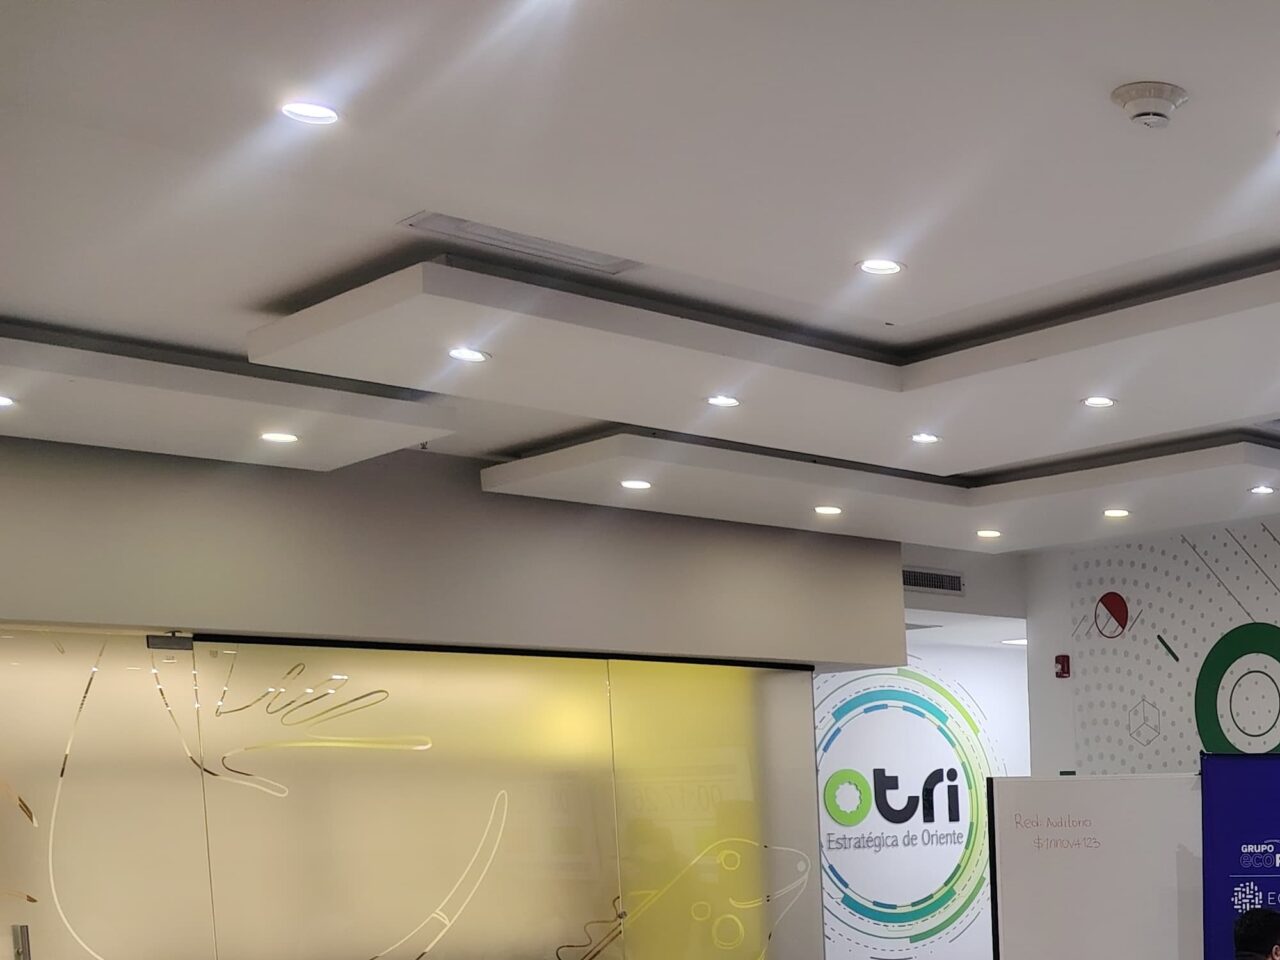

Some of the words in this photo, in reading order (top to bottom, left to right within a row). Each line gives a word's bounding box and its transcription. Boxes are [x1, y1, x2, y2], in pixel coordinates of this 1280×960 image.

[827, 832, 899, 853] Estratégica
[903, 830, 918, 846] de
[921, 829, 964, 846] Oriente
[1241, 844, 1274, 853] GRUPO
